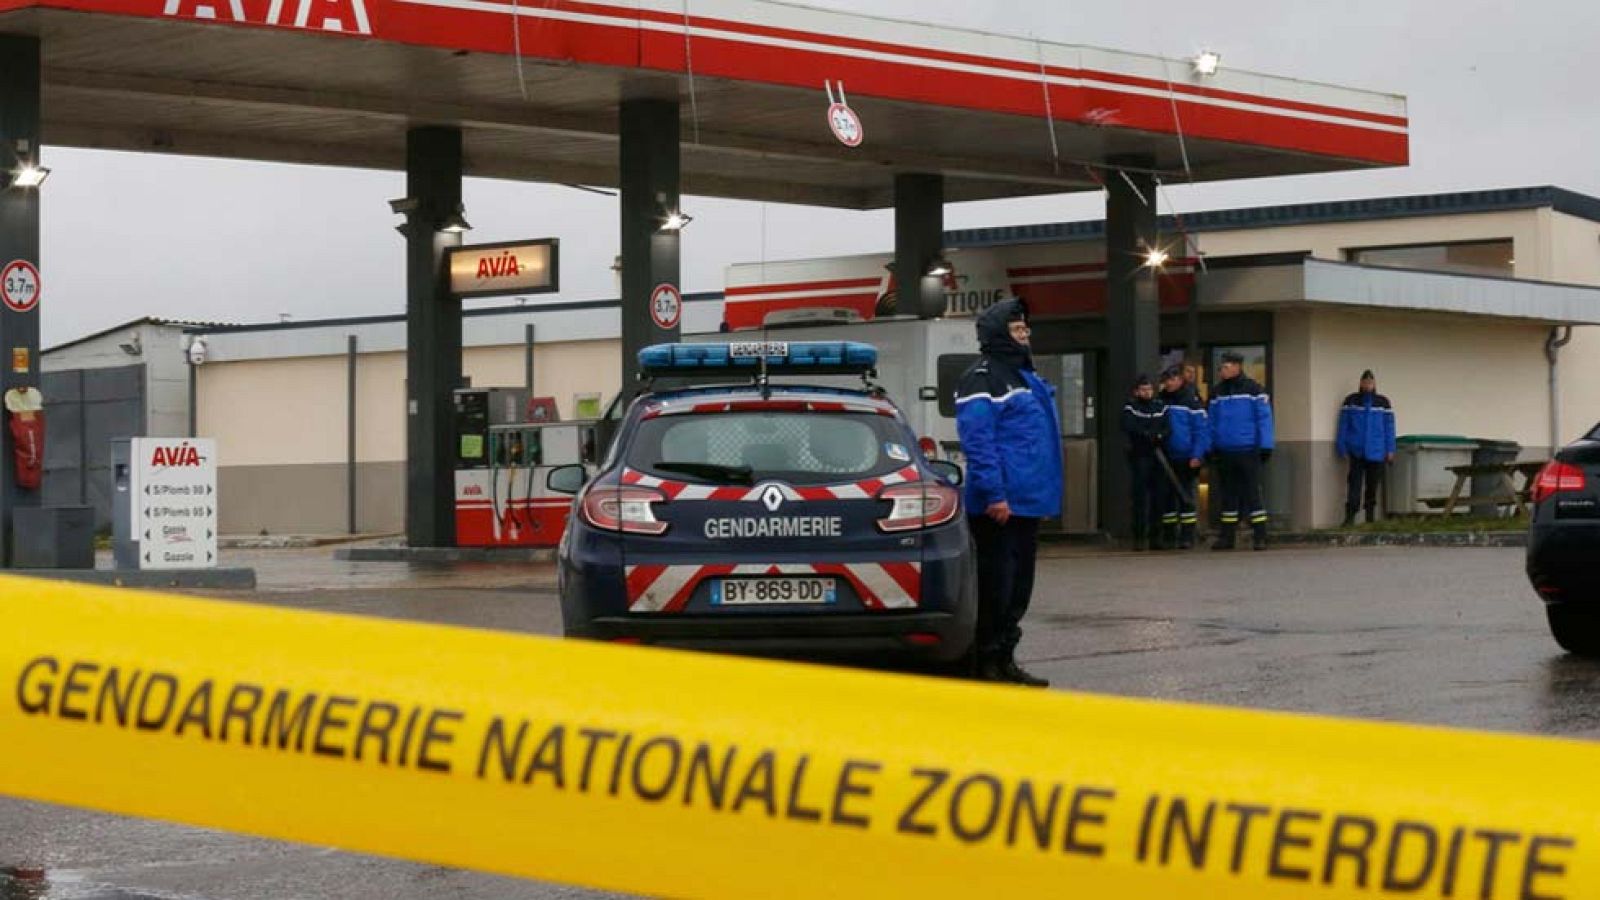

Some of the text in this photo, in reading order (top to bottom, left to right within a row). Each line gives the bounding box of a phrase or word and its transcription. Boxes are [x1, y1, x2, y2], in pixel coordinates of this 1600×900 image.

[477, 251, 519, 278] AVIA
[151, 441, 200, 467] AVIA
[704, 517, 842, 538] GENDARMERIE
[724, 580, 823, 601] BY-869-DD
[16, 656, 1575, 900] GENDARMERIE NATIONALE ZONE INTERDITE
